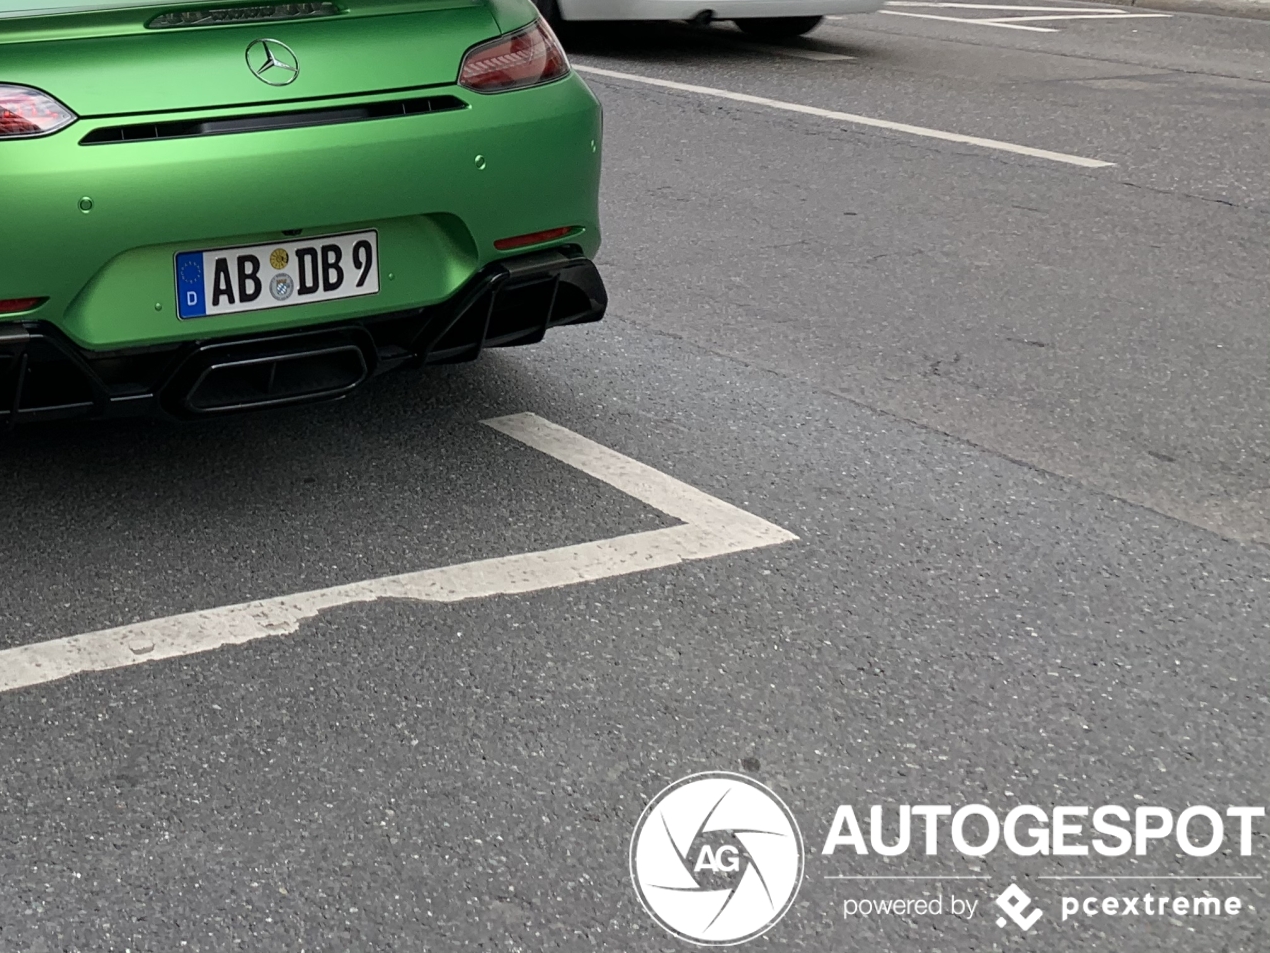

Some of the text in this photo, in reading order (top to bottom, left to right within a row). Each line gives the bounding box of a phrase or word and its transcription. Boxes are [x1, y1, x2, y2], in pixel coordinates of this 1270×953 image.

[212, 239, 373, 306] AB DB 9
[187, 291, 198, 306] D
